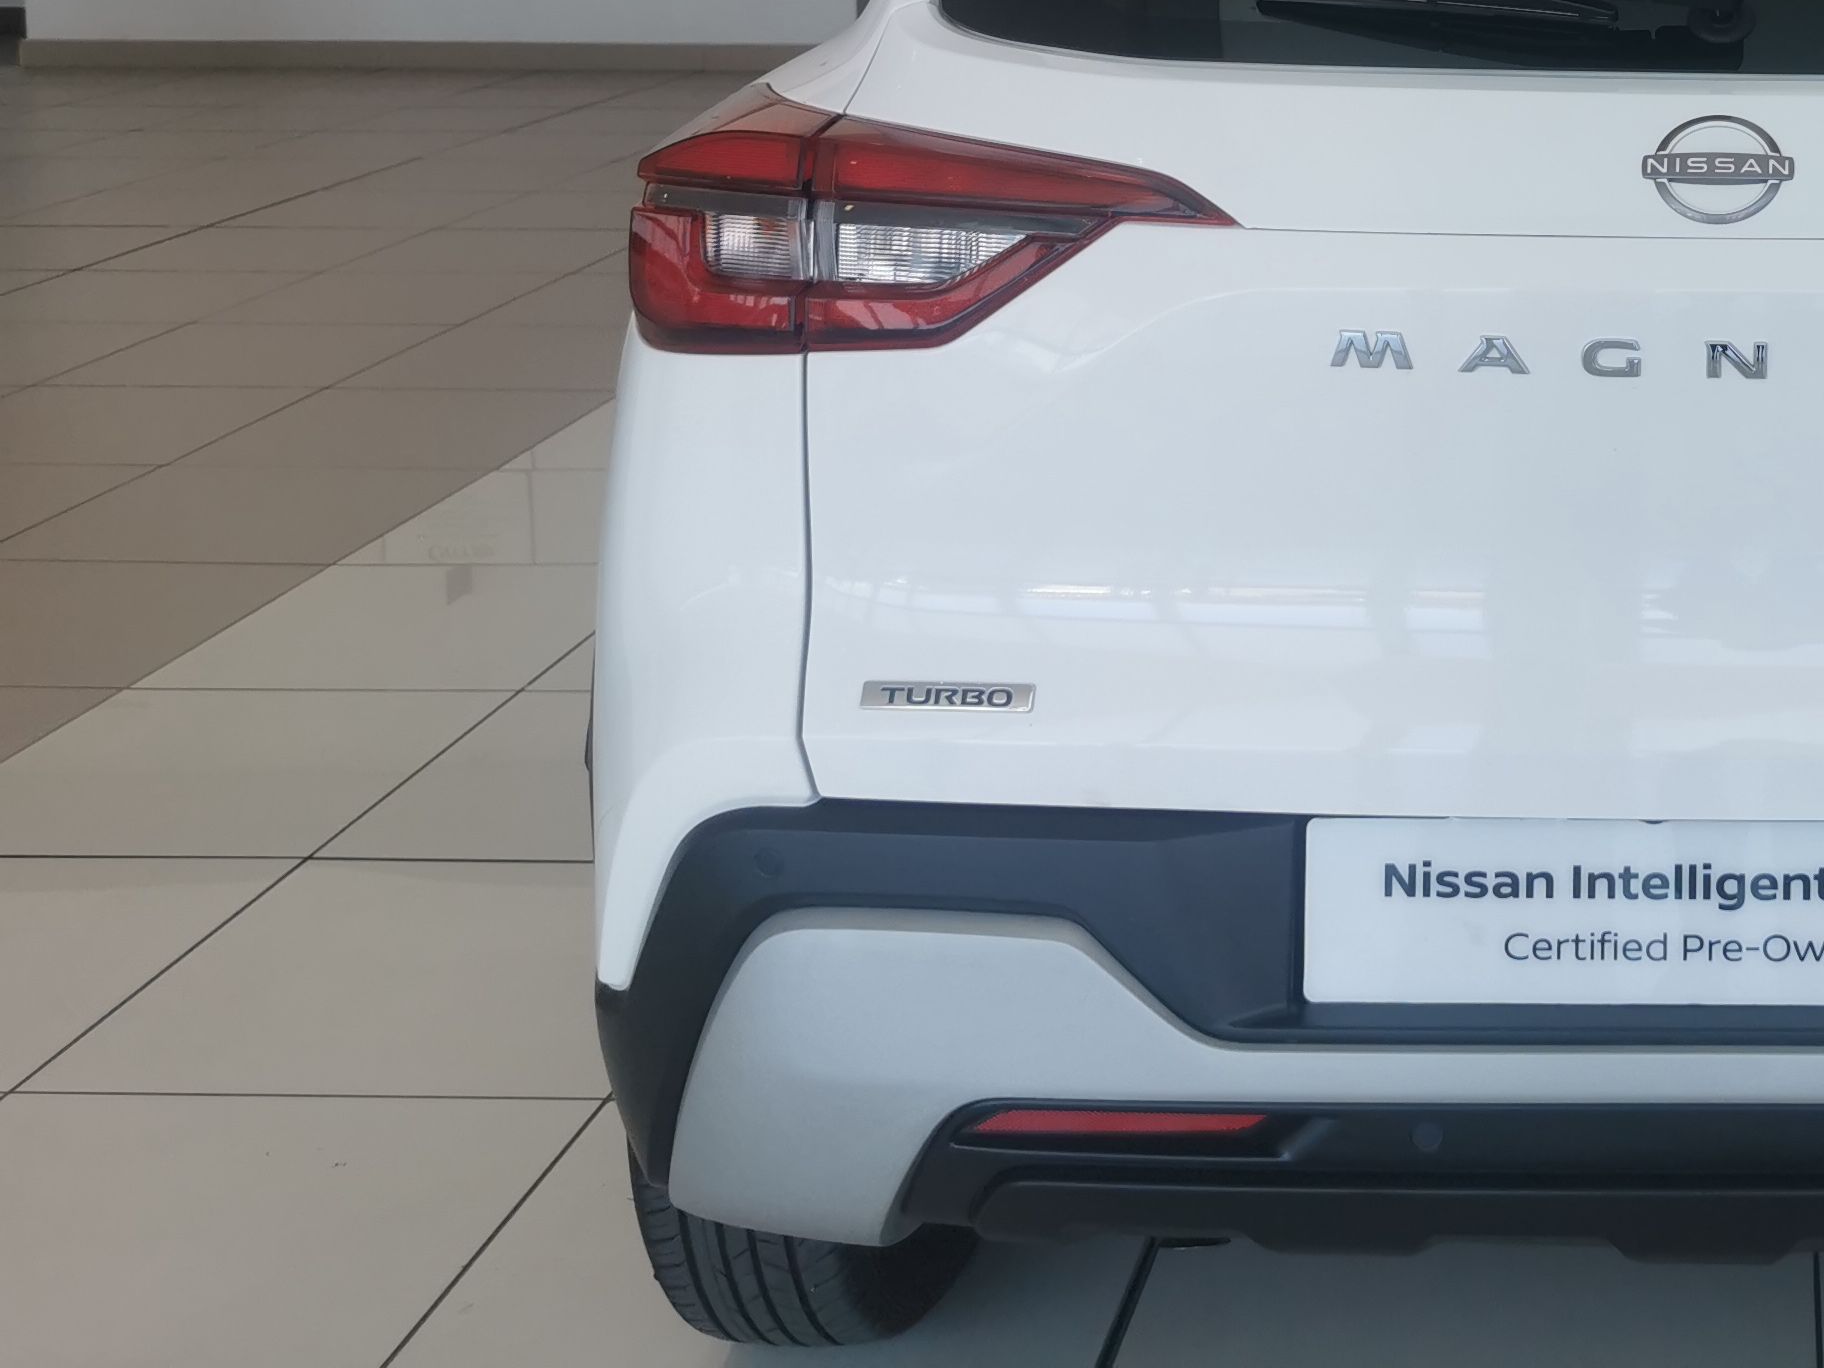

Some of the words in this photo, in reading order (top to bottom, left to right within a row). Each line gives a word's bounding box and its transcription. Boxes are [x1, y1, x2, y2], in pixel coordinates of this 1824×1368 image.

[1647, 157, 1790, 175] NISSAN
[881, 686, 1013, 707] TURBO
[1384, 861, 1555, 900] Nissan
[1504, 931, 1668, 963] Certified
